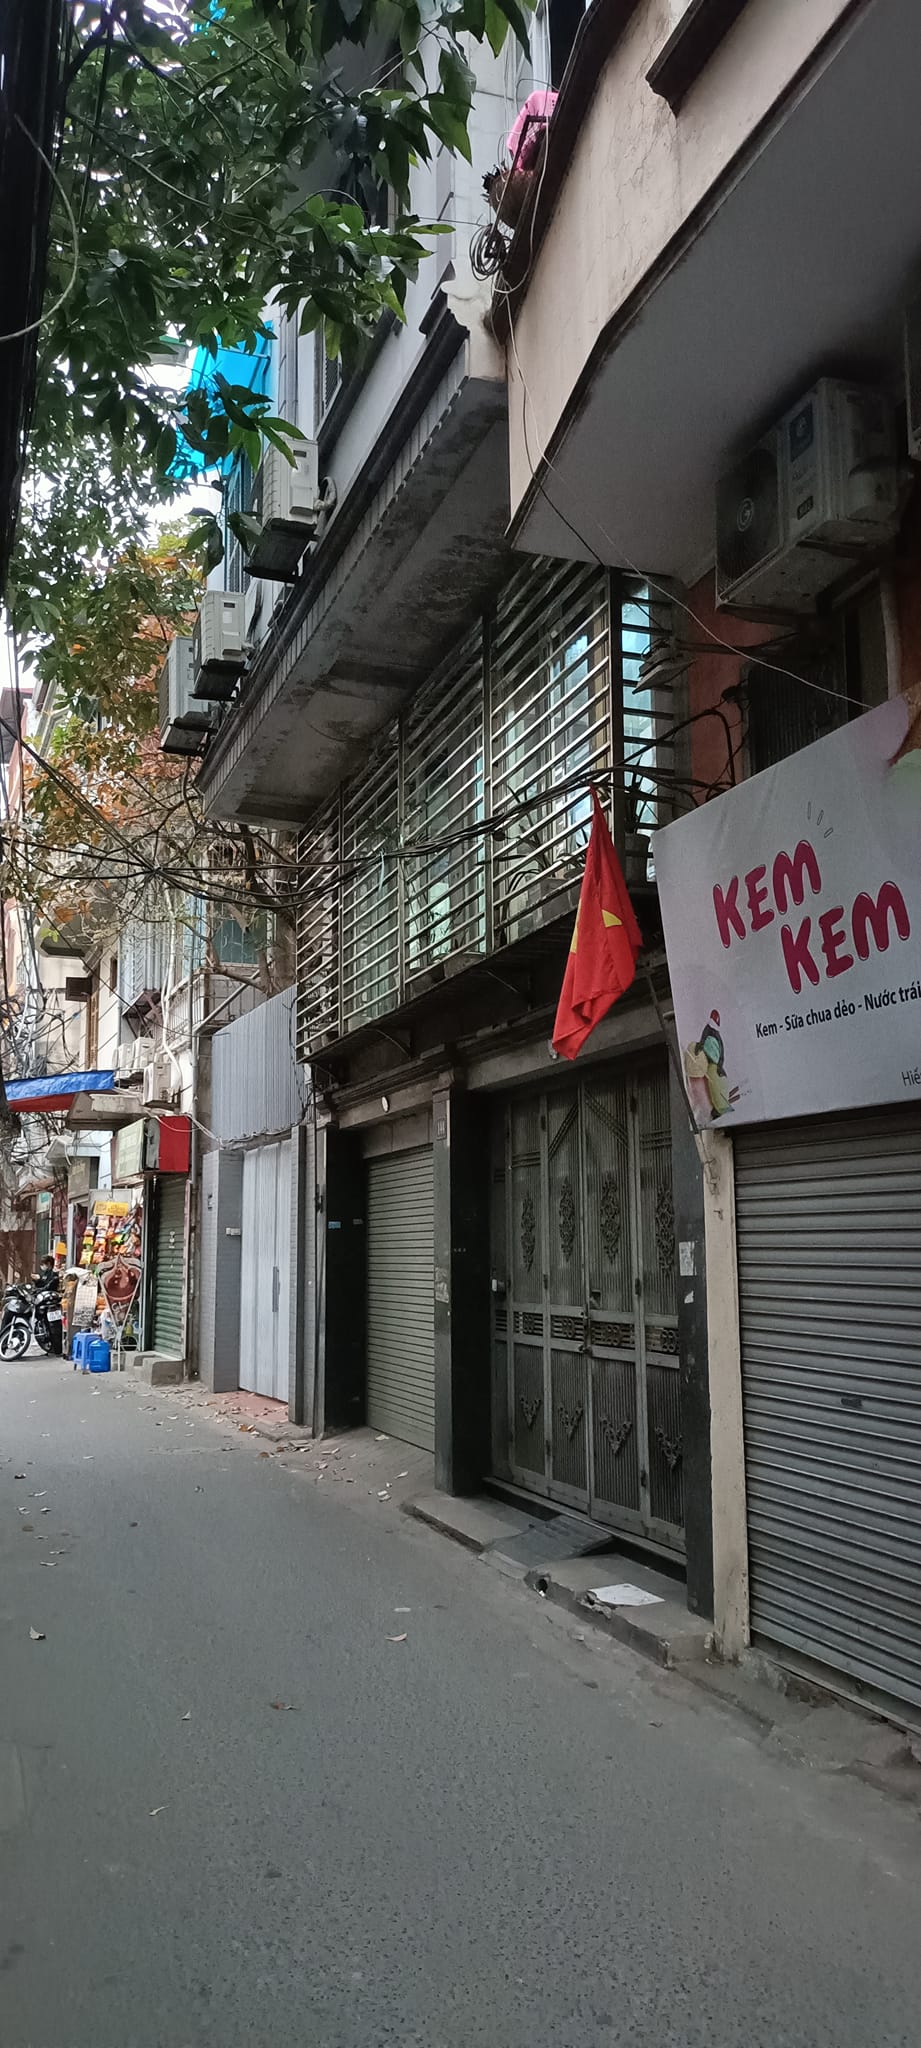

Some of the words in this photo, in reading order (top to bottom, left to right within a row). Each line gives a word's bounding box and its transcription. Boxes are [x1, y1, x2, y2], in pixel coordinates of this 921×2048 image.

[712, 840, 821, 949] KEM
[781, 881, 910, 994] KEM
[755, 1022, 778, 1038] Kem
[784, 1013, 804, 1031] Sữa
[806, 1009, 832, 1026] chua
[834, 999, 856, 1018] dẻo
[864, 989, 897, 1011] Nước
[898, 980, 921, 1003] trái
[901, 1066, 921, 1087] Hiế
